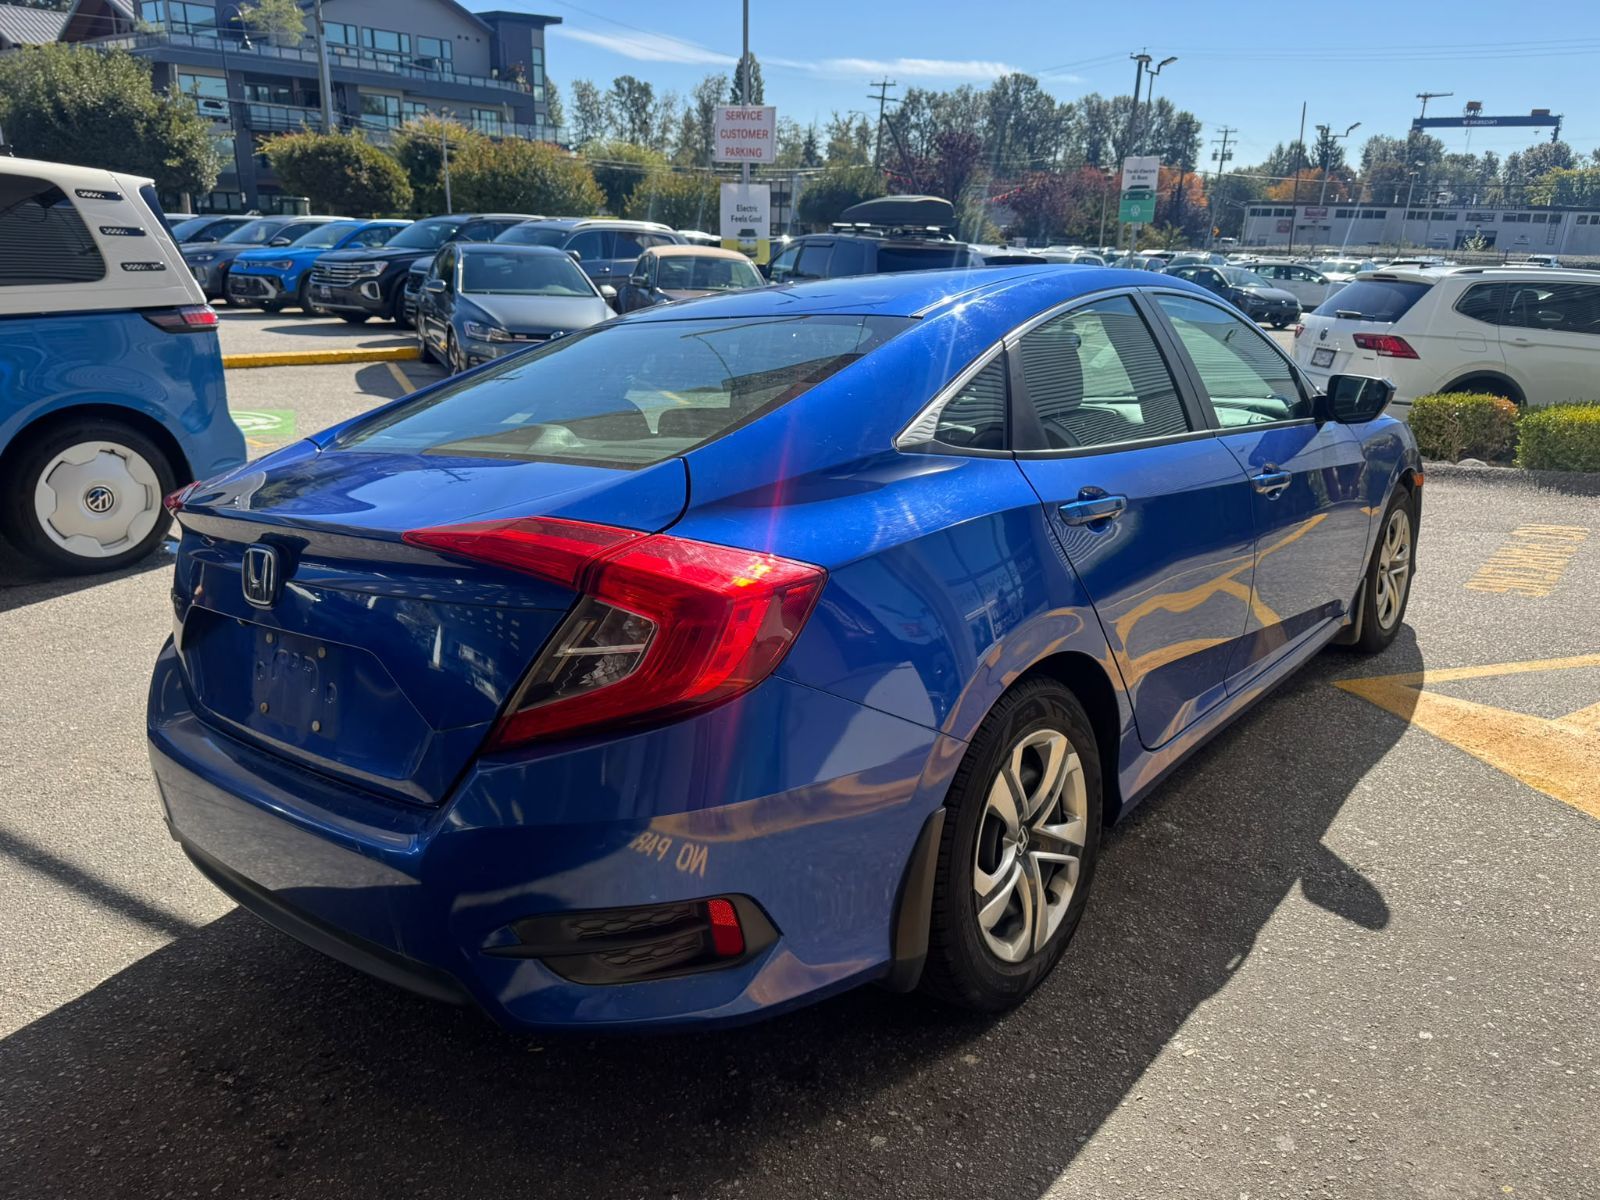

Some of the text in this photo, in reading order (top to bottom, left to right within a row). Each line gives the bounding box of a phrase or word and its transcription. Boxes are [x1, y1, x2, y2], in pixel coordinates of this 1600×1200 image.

[725, 110, 762, 121] SERVICE
[720, 129, 769, 139] CUSTOMER
[725, 147, 762, 158] PARKING
[736, 203, 758, 213] Electric
[730, 214, 763, 223] Feels Good
